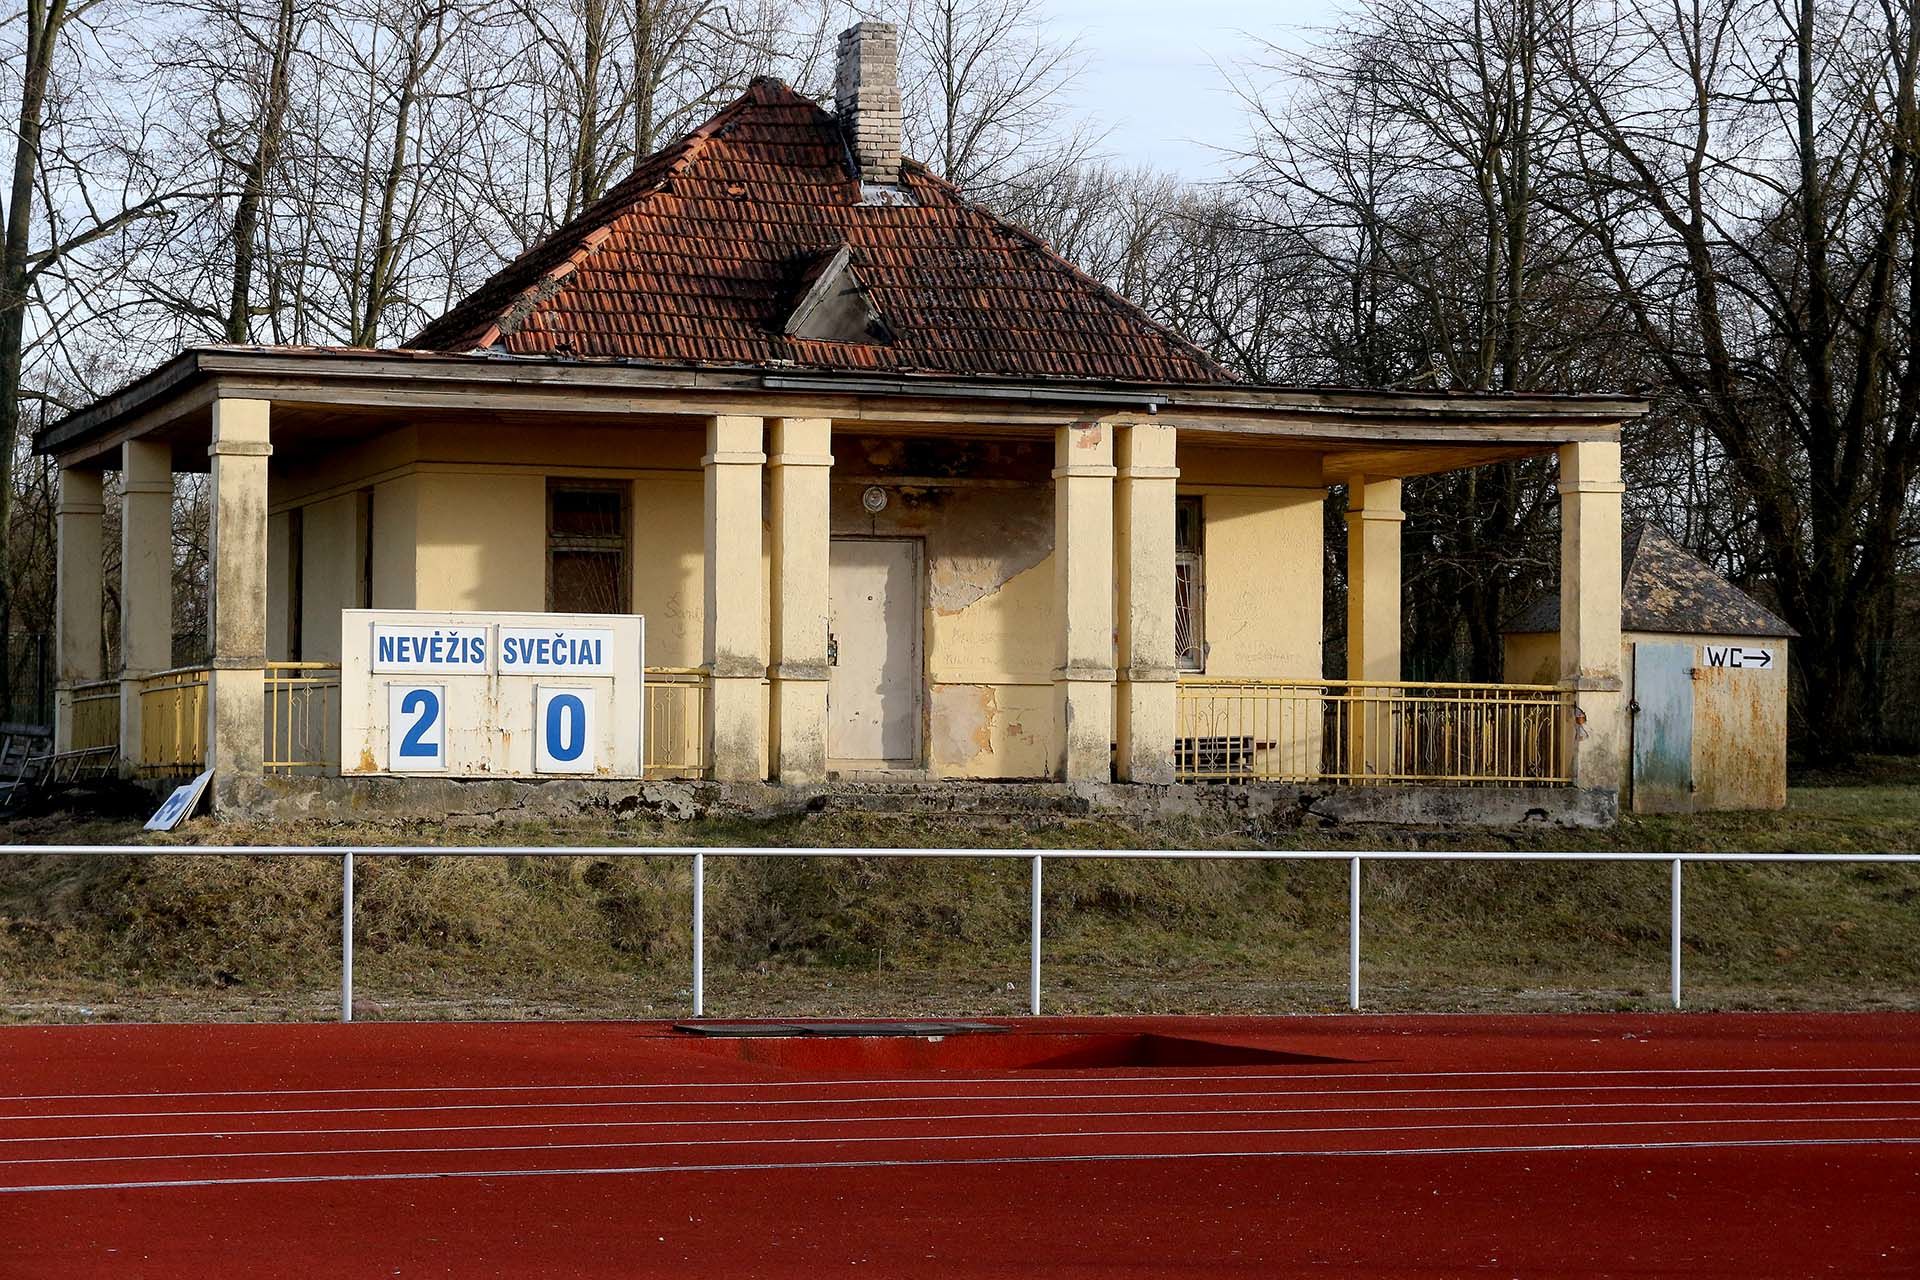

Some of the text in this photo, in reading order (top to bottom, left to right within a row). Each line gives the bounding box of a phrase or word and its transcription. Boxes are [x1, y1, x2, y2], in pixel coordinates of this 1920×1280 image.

[379, 630, 485, 664] NEVĖŽIS
[503, 632, 601, 665] SVEČIAI
[1707, 646, 1742, 668] WC
[399, 689, 439, 757] 2
[546, 693, 586, 762] 0
